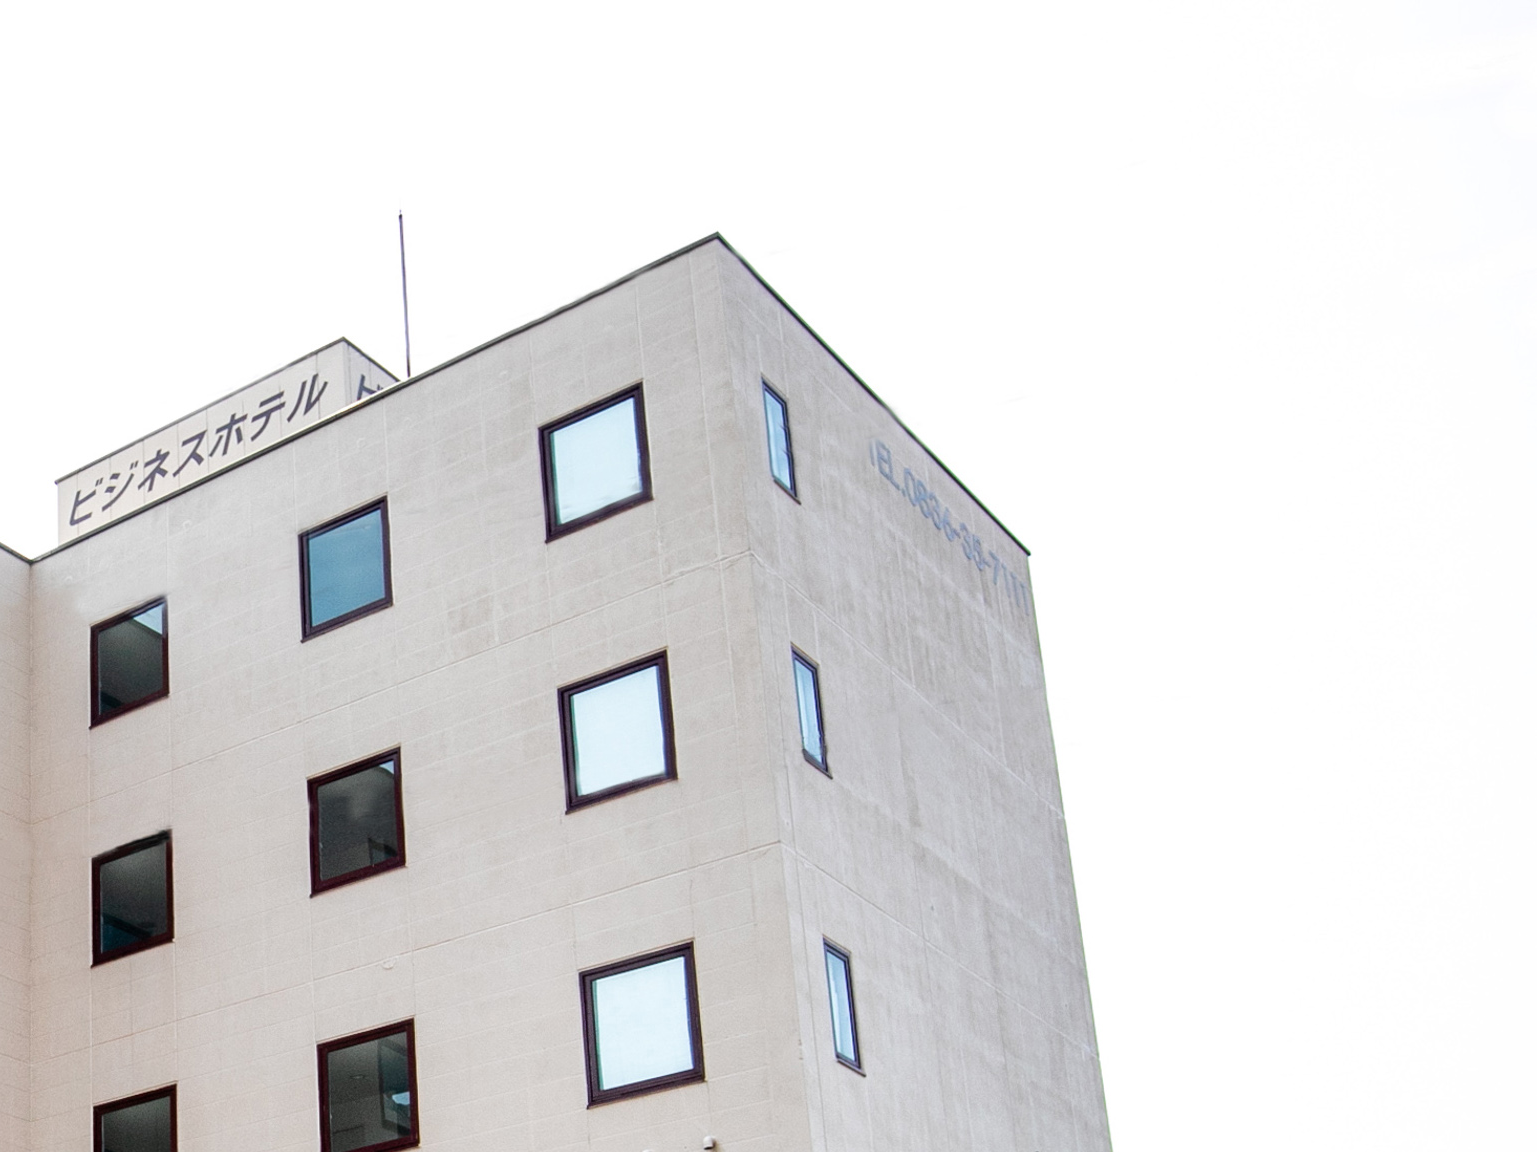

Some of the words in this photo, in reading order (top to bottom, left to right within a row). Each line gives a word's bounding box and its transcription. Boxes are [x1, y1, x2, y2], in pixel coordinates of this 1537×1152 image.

[69, 373, 328, 526] ビジネスホテル
